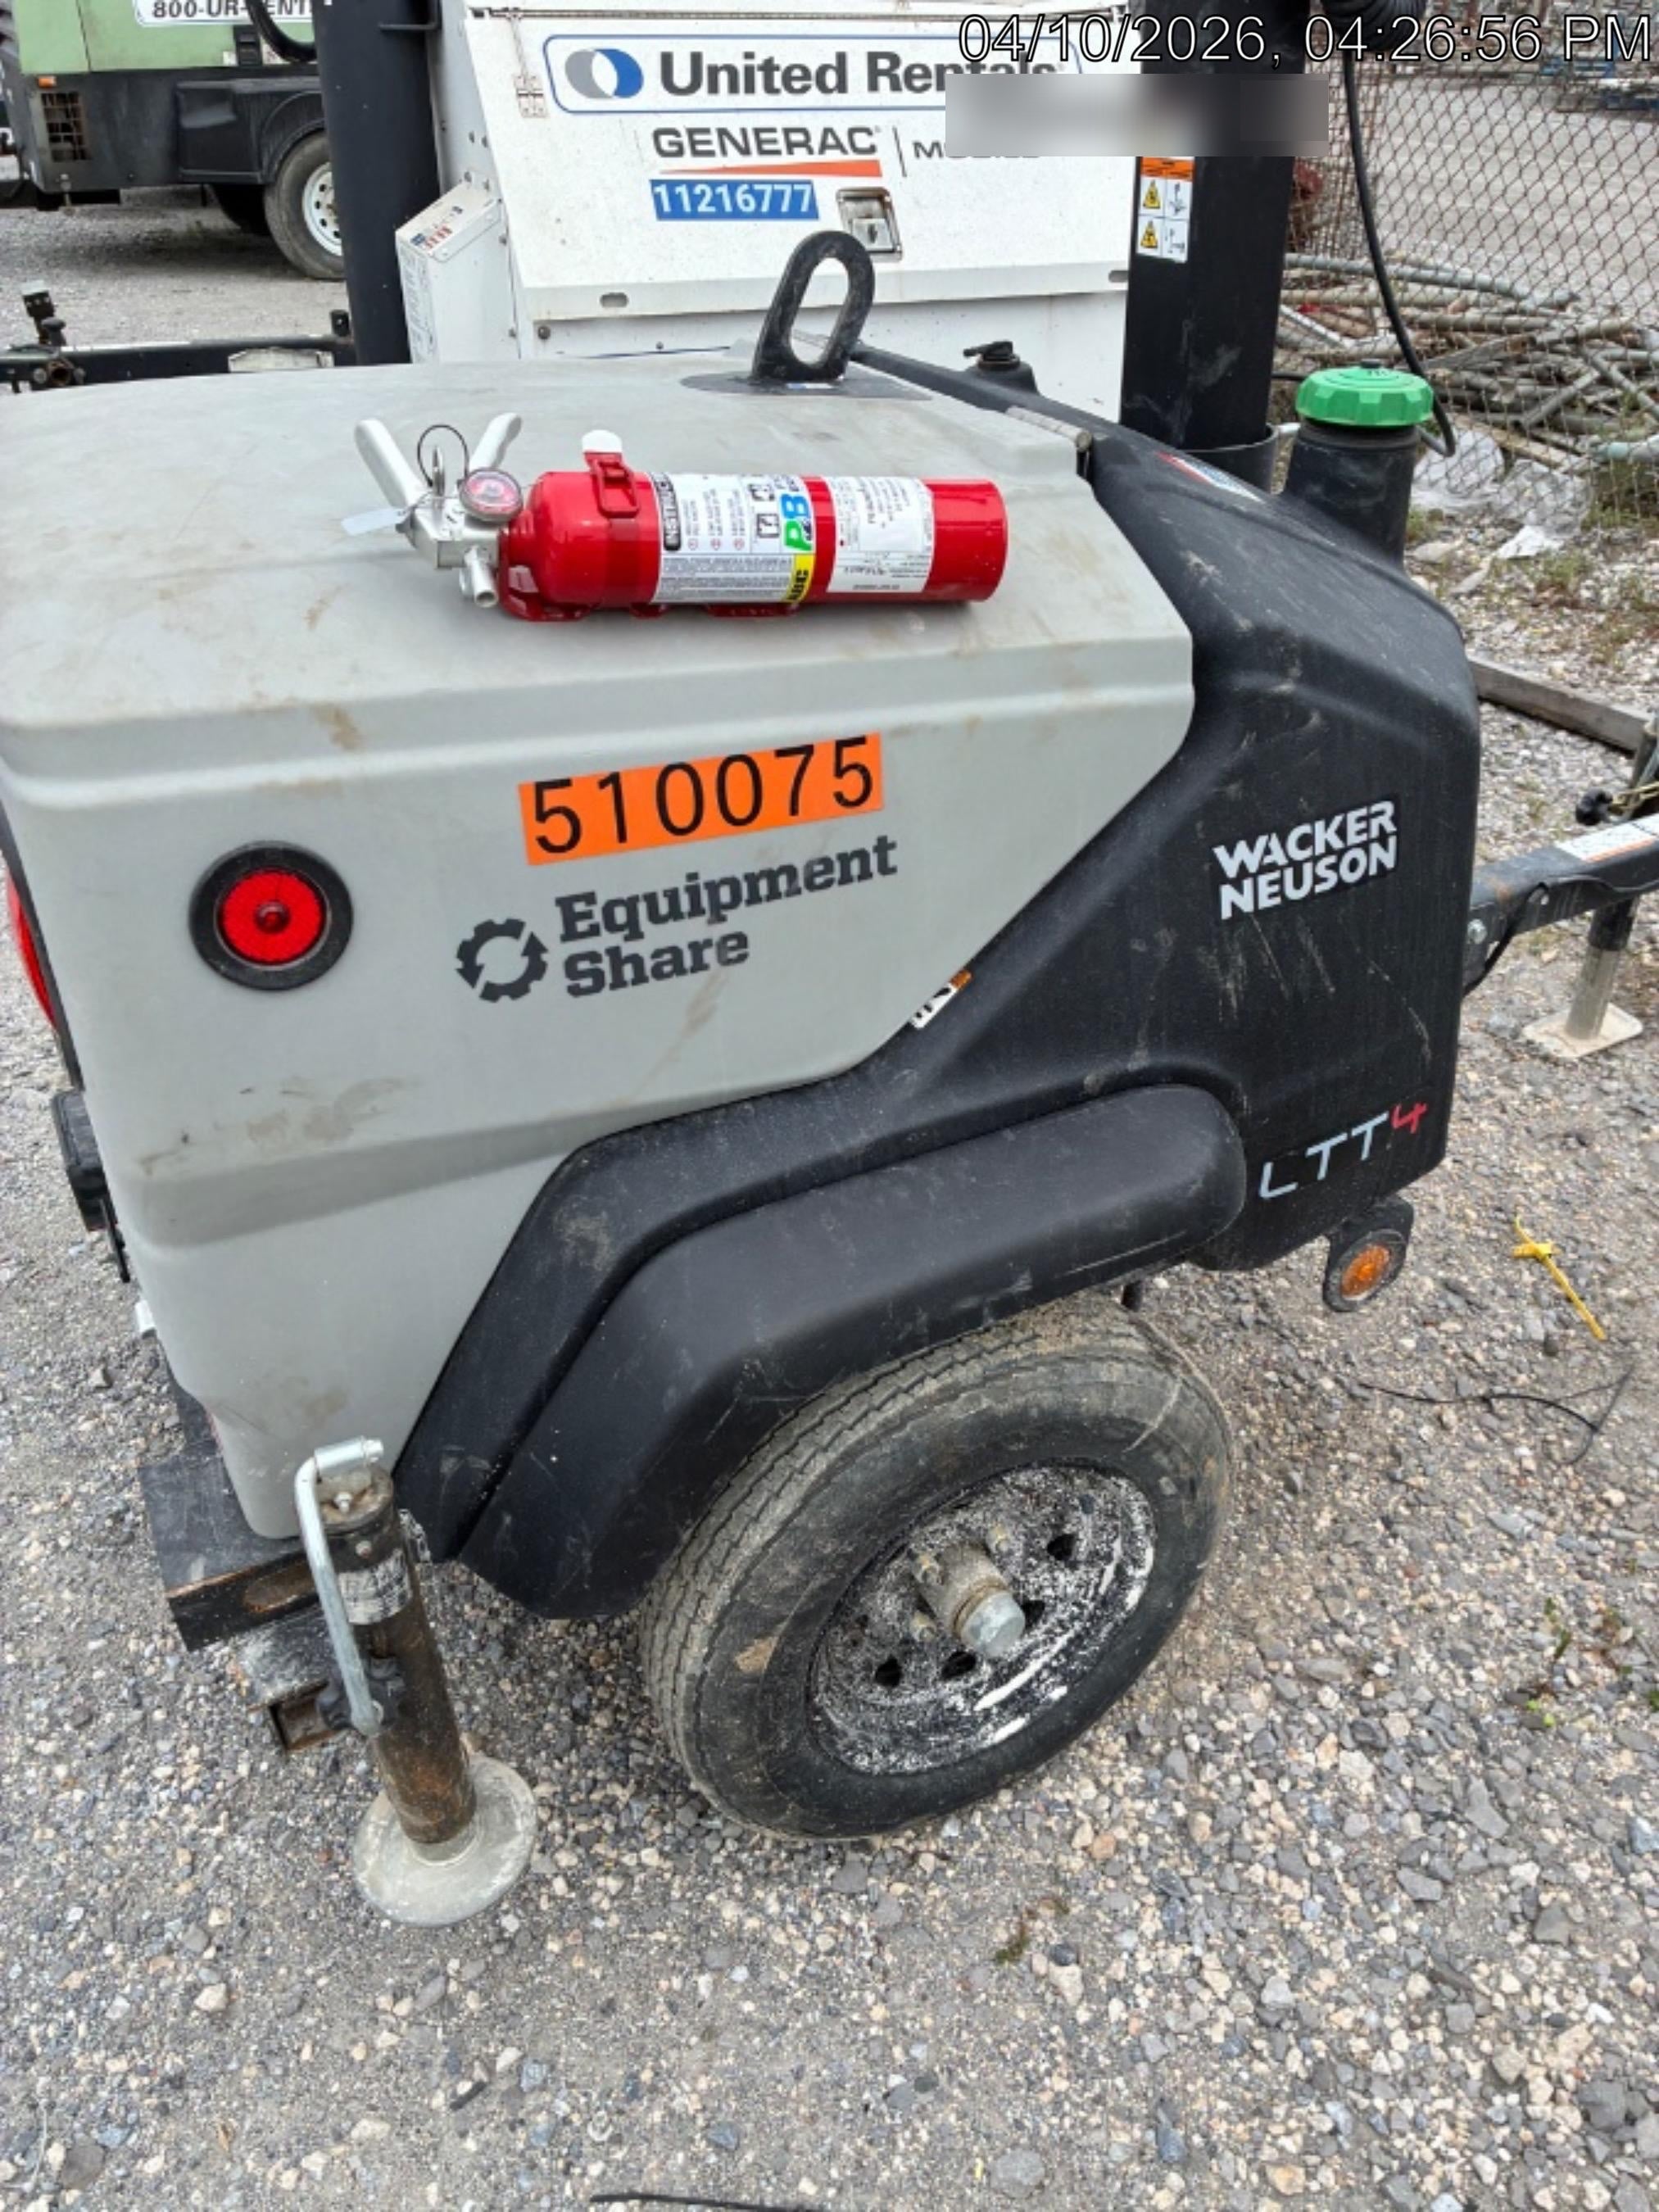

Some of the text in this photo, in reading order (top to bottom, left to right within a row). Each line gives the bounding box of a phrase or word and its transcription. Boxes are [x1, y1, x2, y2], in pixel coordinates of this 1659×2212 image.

[660, 51, 849, 96] United
[652, 127, 877, 158] GENERAC
[654, 184, 812, 213] 11216777
[534, 735, 873, 854] 510075
[1213, 800, 1397, 878] WACKER
[1219, 834, 1397, 920] NEUSON
[555, 835, 898, 943] Equipment
[564, 931, 750, 998] Share
[1259, 1103, 1428, 1200] LTT4
